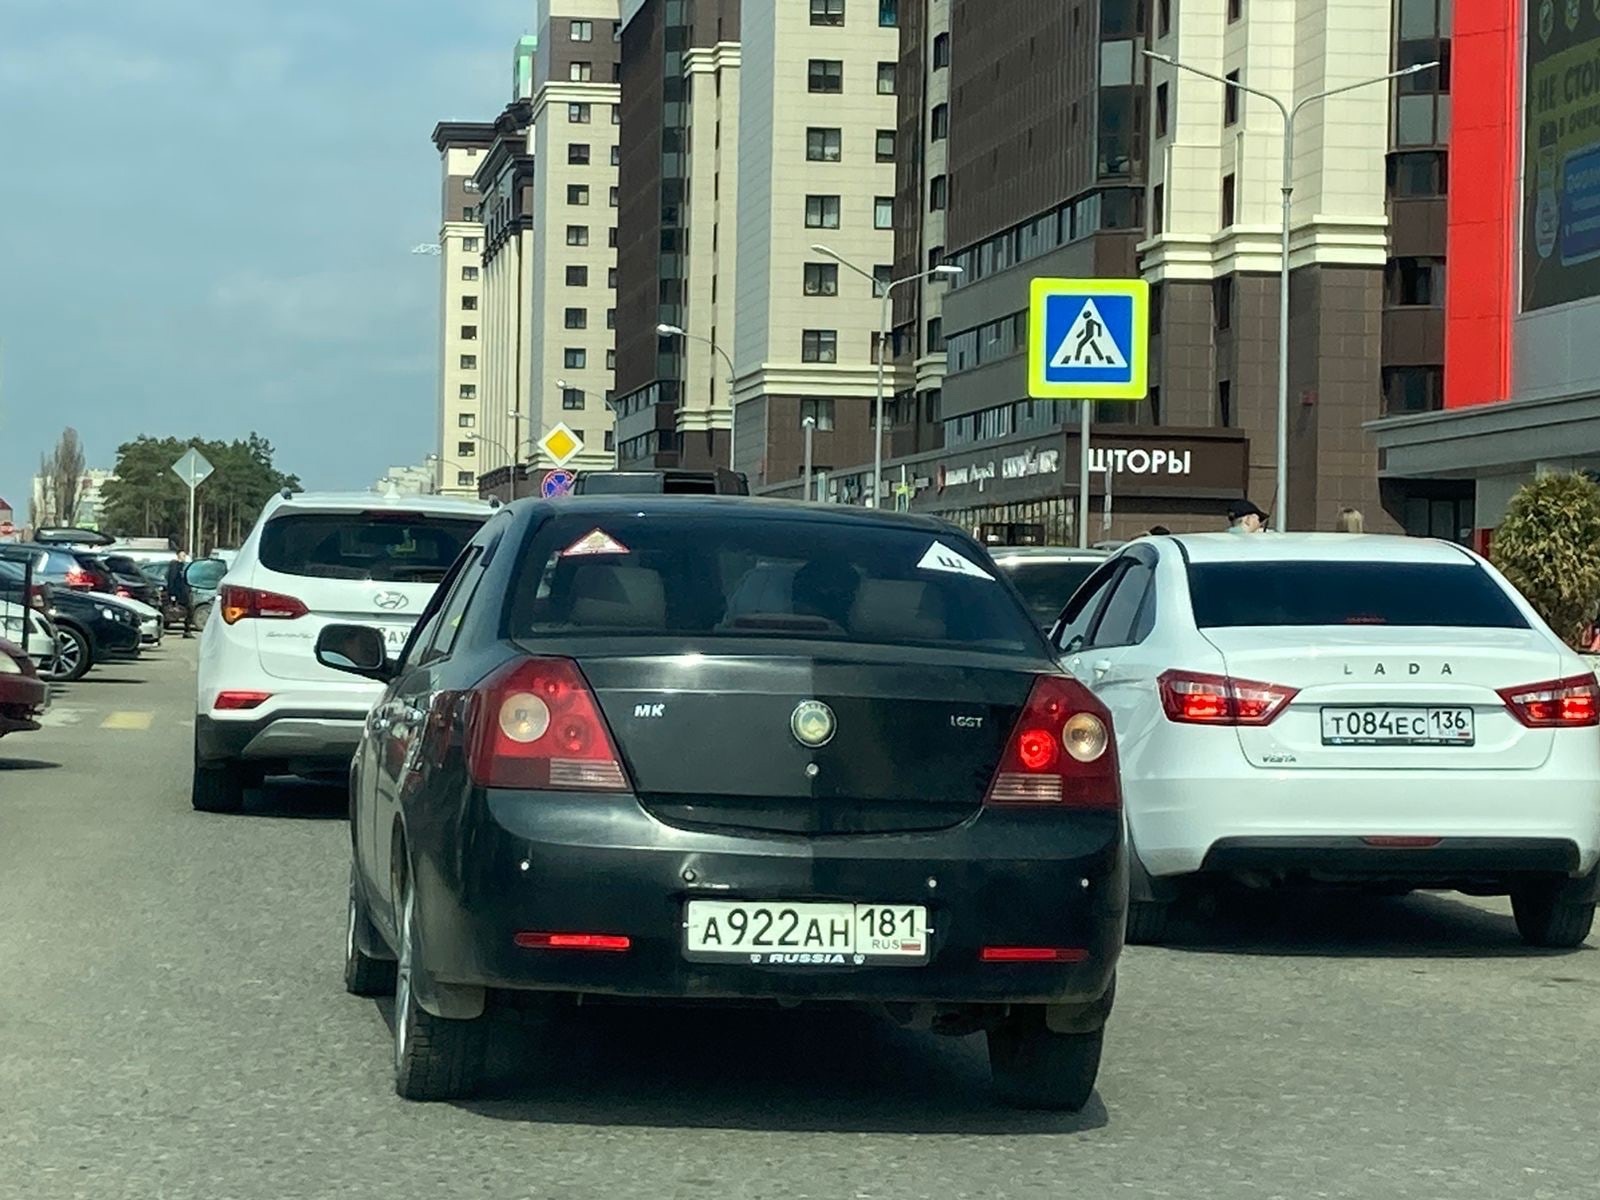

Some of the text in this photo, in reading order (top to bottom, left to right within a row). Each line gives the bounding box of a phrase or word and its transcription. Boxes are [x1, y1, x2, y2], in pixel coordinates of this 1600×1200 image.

[1087, 448, 1191, 475] ШТОРЫ
[1344, 663, 1452, 675] LADA
[634, 703, 665, 717] MK
[1331, 711, 1466, 736] Т084ЕС 136
[701, 908, 915, 947] А922АН 181
[872, 939, 899, 950] RUS
[769, 953, 845, 964] RUSSIA
